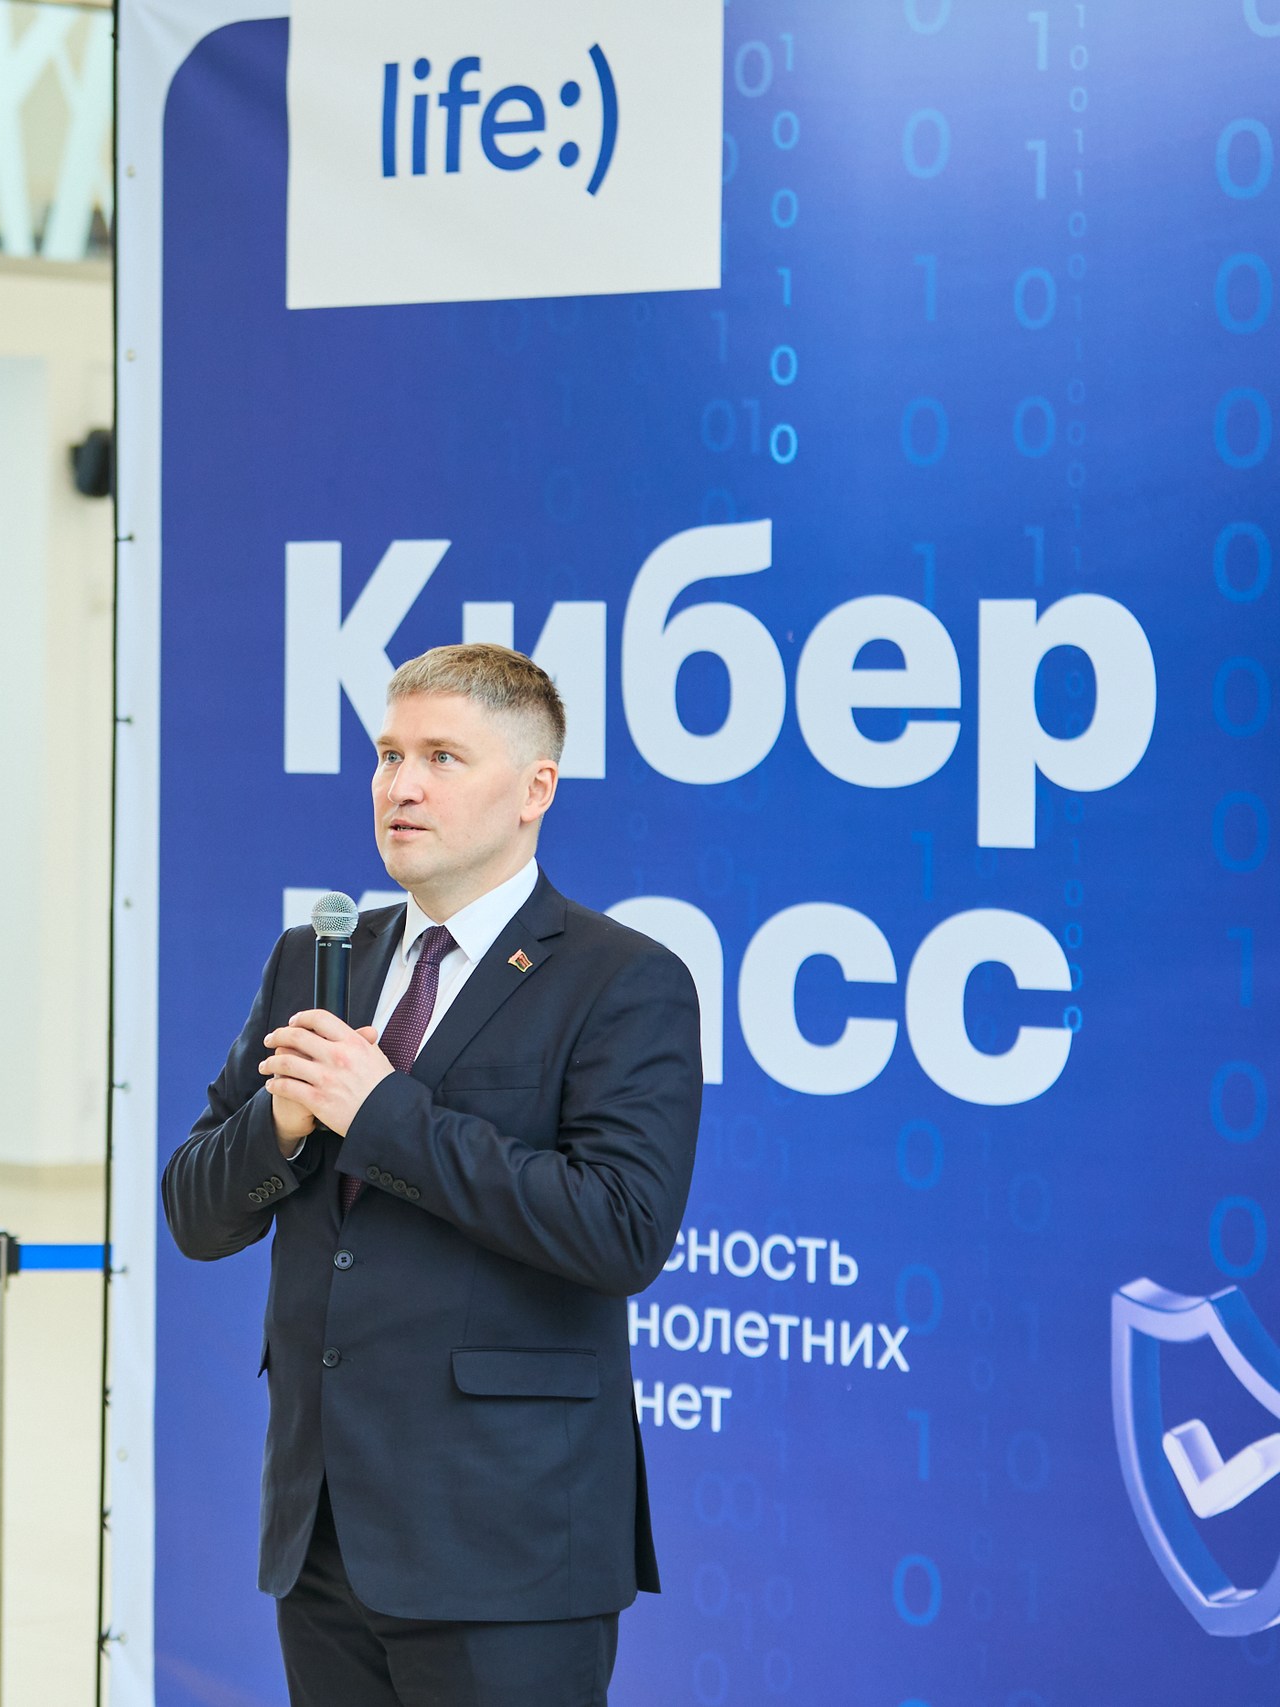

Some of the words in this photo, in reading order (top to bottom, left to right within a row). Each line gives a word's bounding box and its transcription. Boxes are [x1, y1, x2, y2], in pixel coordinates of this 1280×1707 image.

[381, 42, 619, 197] life:)
[283, 519, 1158, 850] Кибер
[627, 1300, 910, 1373] нолетних
